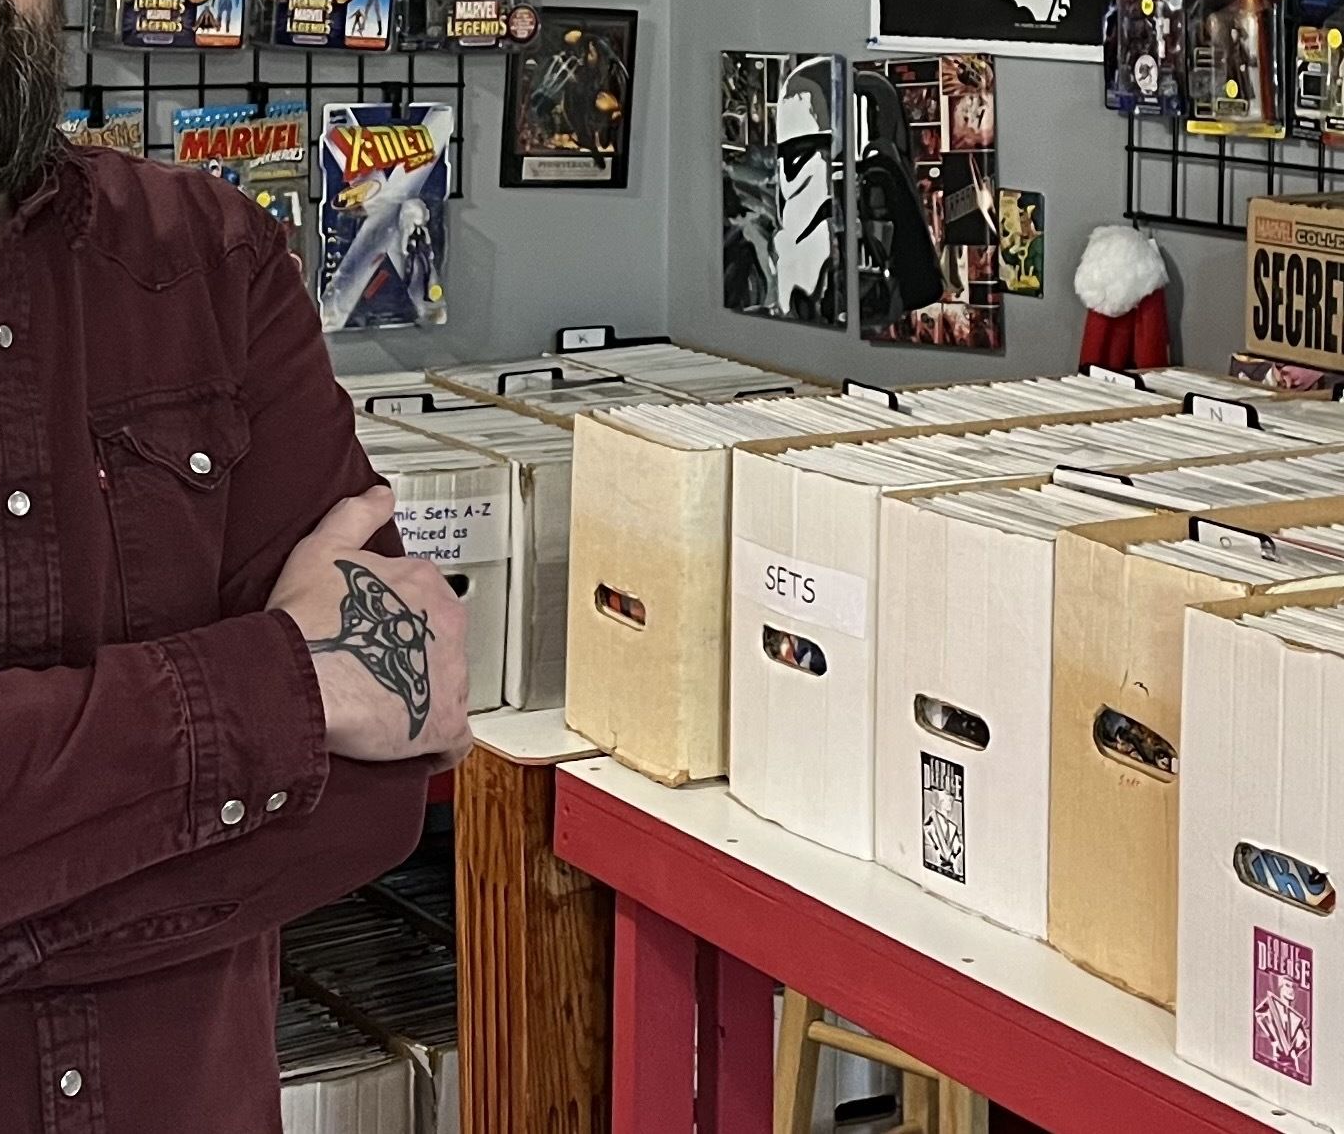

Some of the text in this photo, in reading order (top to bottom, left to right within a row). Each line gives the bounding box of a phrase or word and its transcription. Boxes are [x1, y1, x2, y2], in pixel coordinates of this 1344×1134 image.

[455, 0, 497, 19] MARVEL
[136, 18, 183, 32] LEGENDS
[447, 16, 507, 38] LEGENDS
[180, 123, 302, 162] MARVEL
[336, 125, 434, 170] X-MEN
[1256, 217, 1293, 243] MARVEL
[391, 401, 401, 414] H
[1209, 407, 1223, 422] N
[393, 502, 492, 522] mic Sets A-Z
[401, 526, 468, 541] Priced as
[407, 545, 461, 560] marked
[765, 564, 817, 605] SETS
[1257, 940, 1311, 990] DEFENSE
